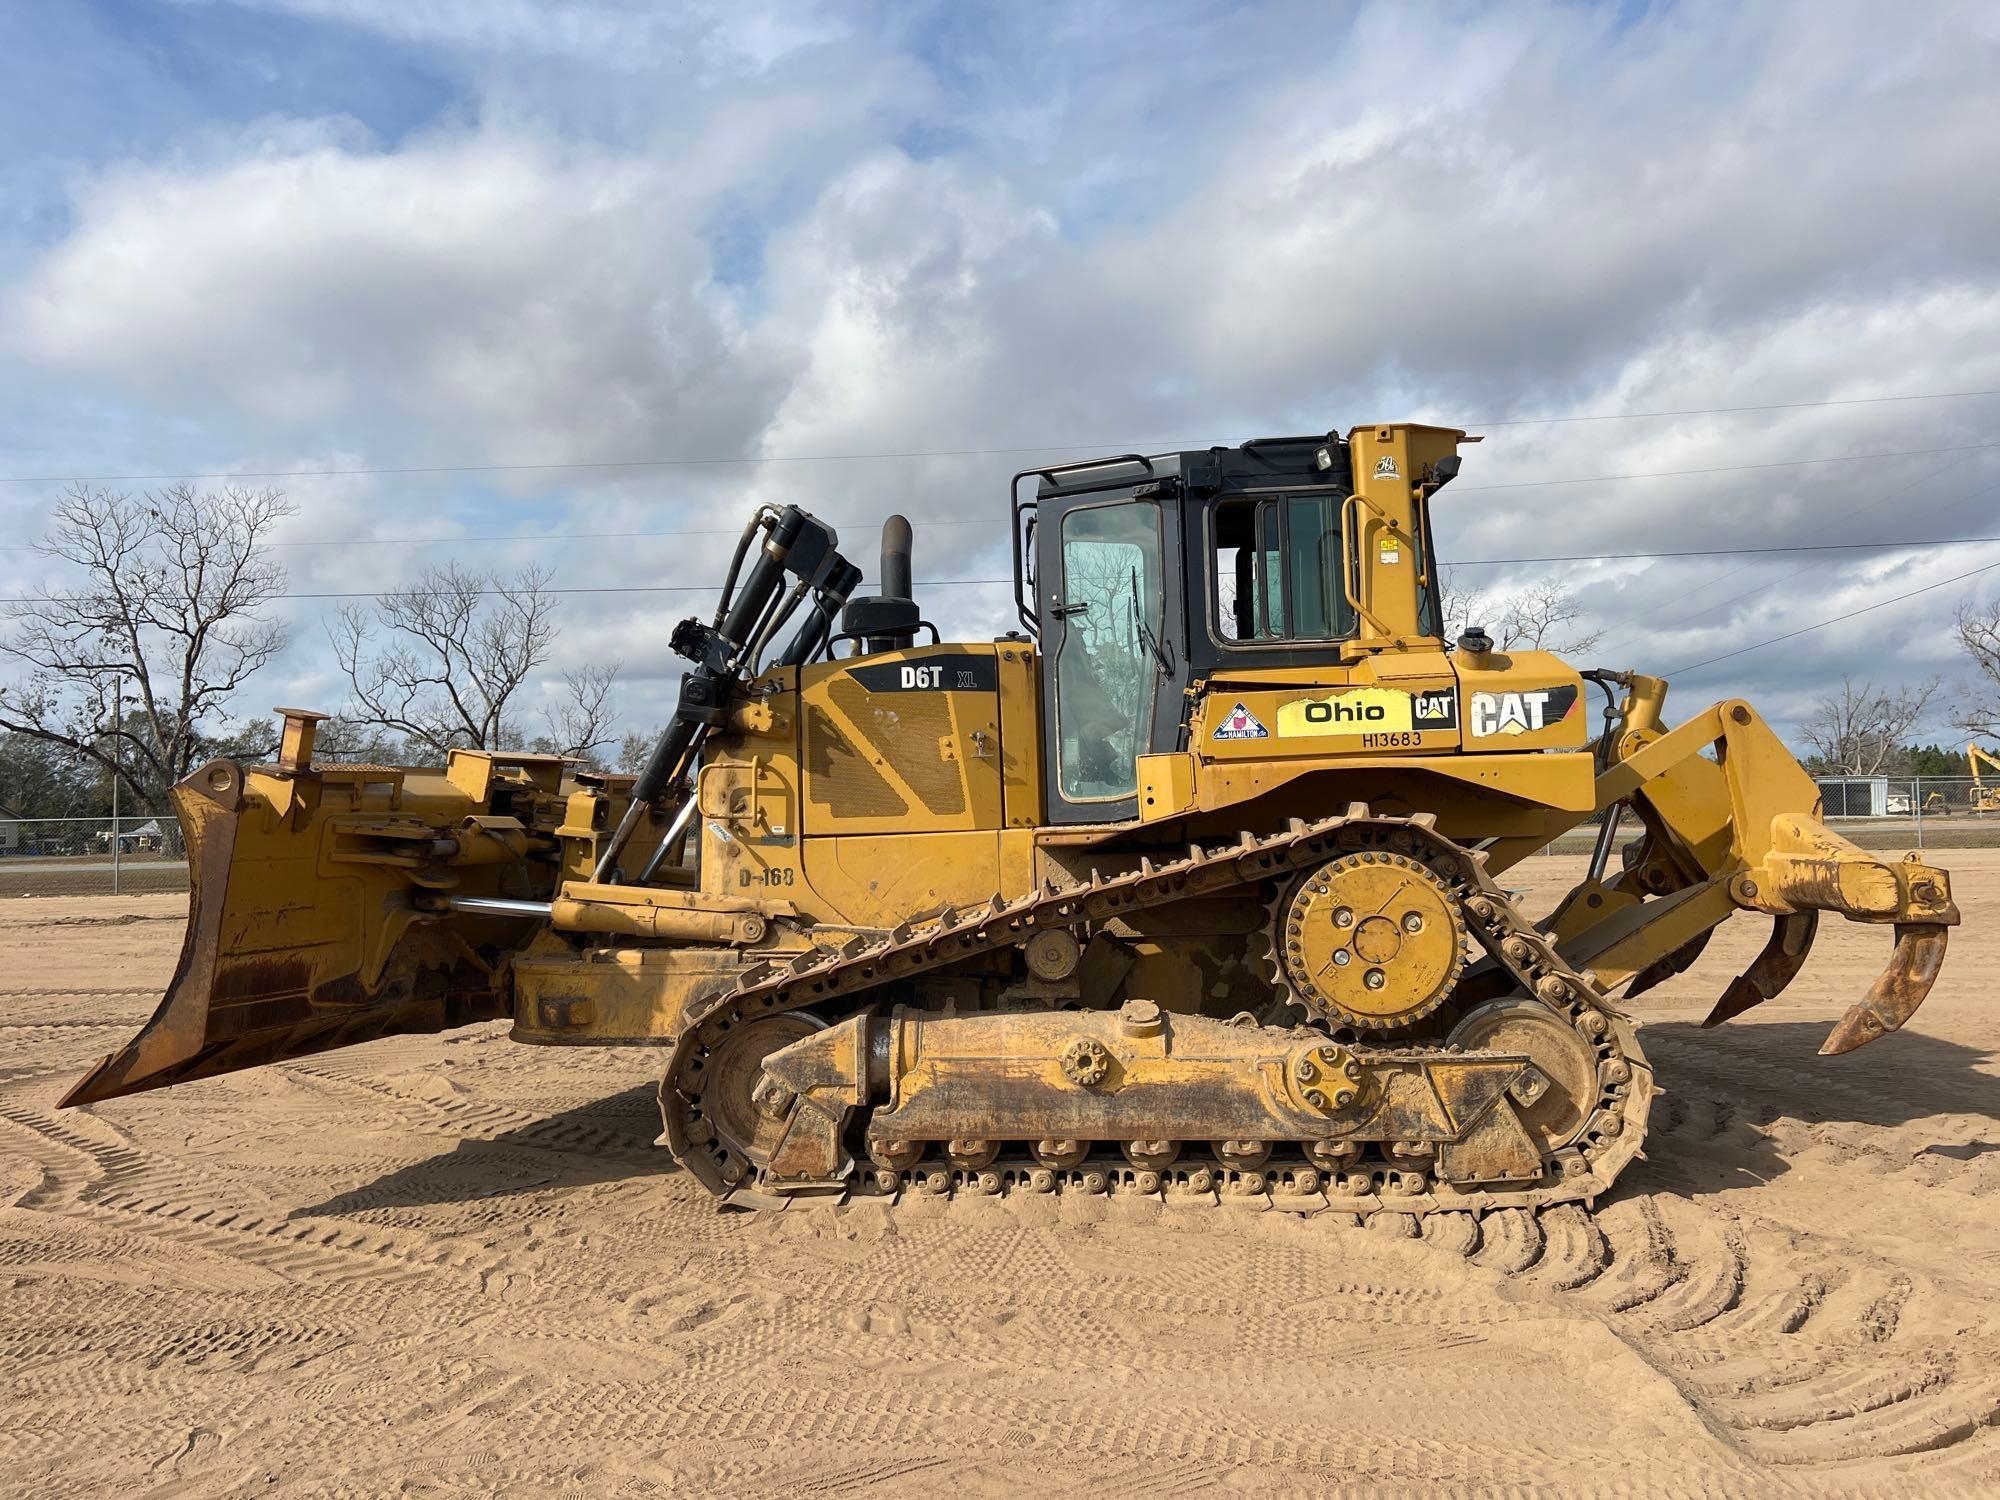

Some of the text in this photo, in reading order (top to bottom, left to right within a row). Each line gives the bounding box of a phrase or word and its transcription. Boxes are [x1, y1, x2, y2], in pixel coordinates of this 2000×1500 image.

[901, 666, 977, 689] D6T XL
[1305, 696, 1451, 722] Ohio CAT
[1471, 692, 1549, 737] CAT
[1229, 729, 1258, 739] HAMILTON
[1363, 732, 1422, 748] H13683
